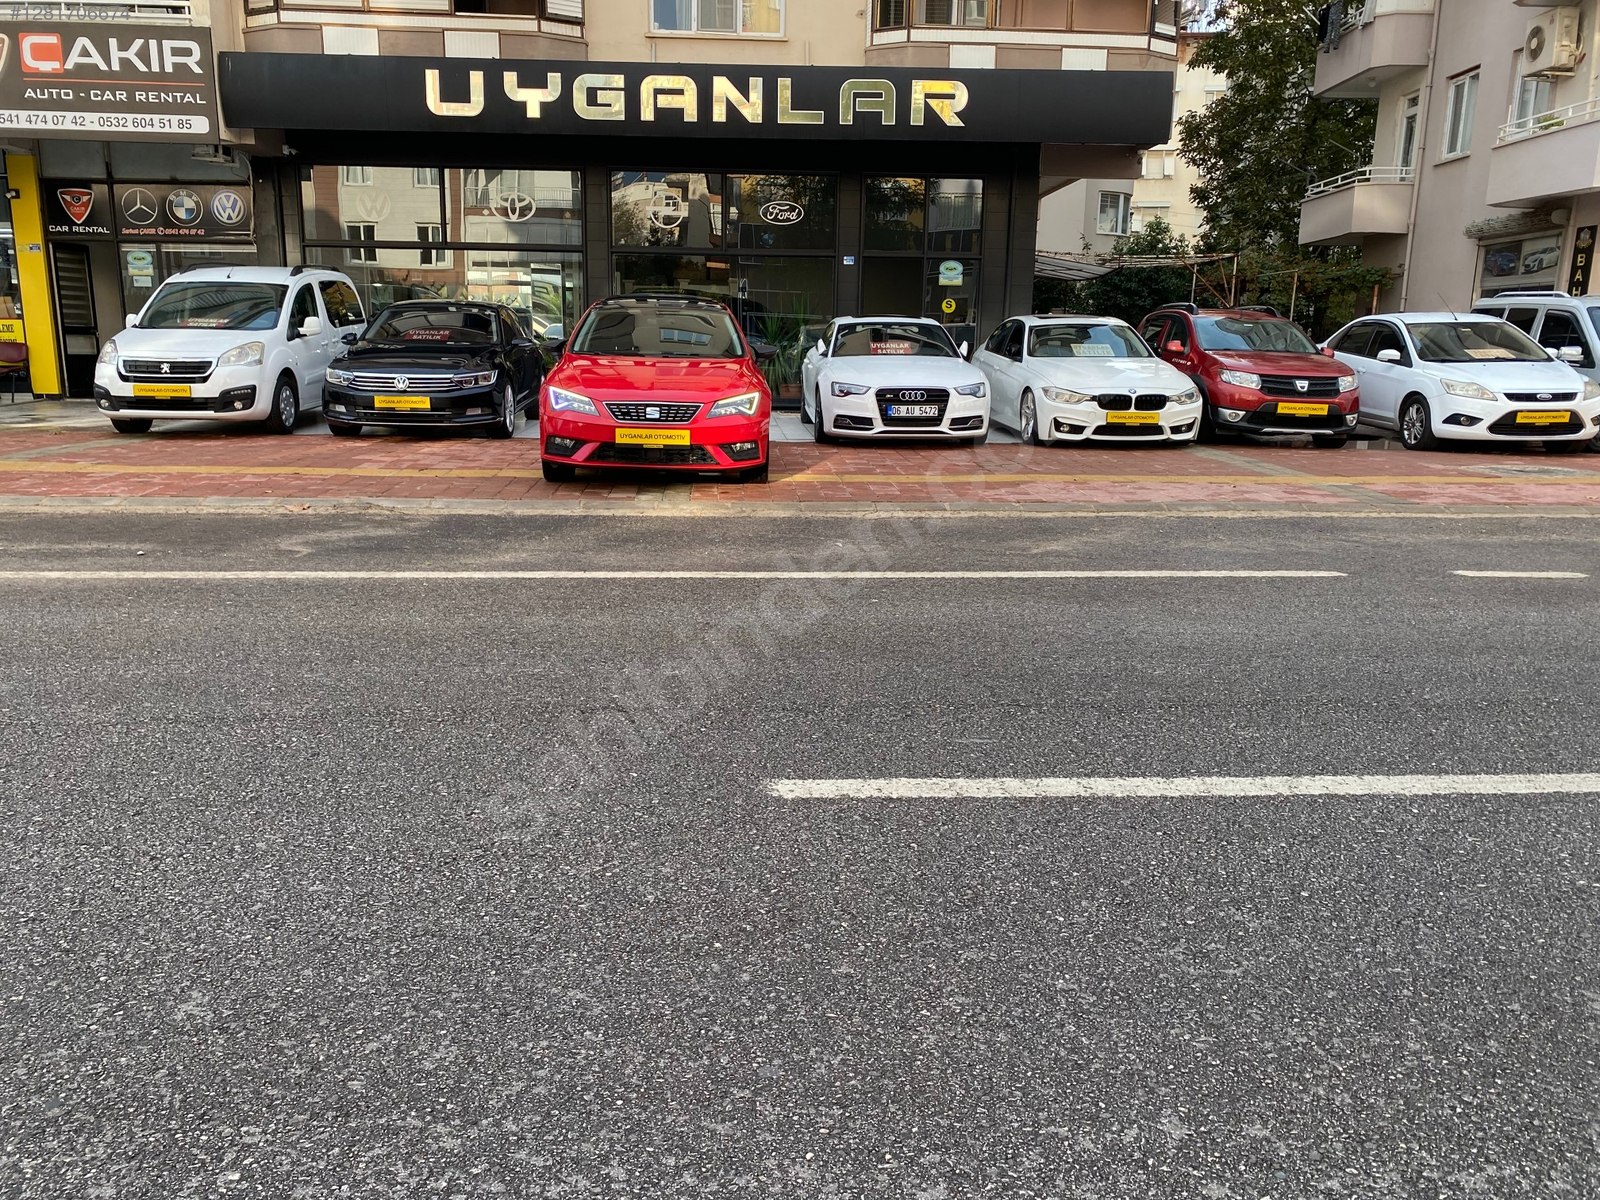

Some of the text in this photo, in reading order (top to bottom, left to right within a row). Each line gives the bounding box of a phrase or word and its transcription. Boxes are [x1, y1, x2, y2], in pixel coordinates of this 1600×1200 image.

[21, 34, 204, 74] ÇAKIR
[24, 87, 73, 99] AUTO
[90, 89, 128, 102] CAR
[135, 91, 207, 104] RENTAL
[424, 68, 970, 127] UYGANLAR
[25, 114, 48, 125] 474
[52, 115, 66, 126] 07
[71, 116, 86, 127] 42
[98, 116, 128, 128] 0532
[132, 117, 154, 129] 604
[158, 118, 172, 129] 51
[177, 118, 193, 130] 85
[767, 204, 800, 220] Ford
[48, 225, 110, 234] CAR RENTAL
[892, 406, 938, 415] 06 AU 5472
